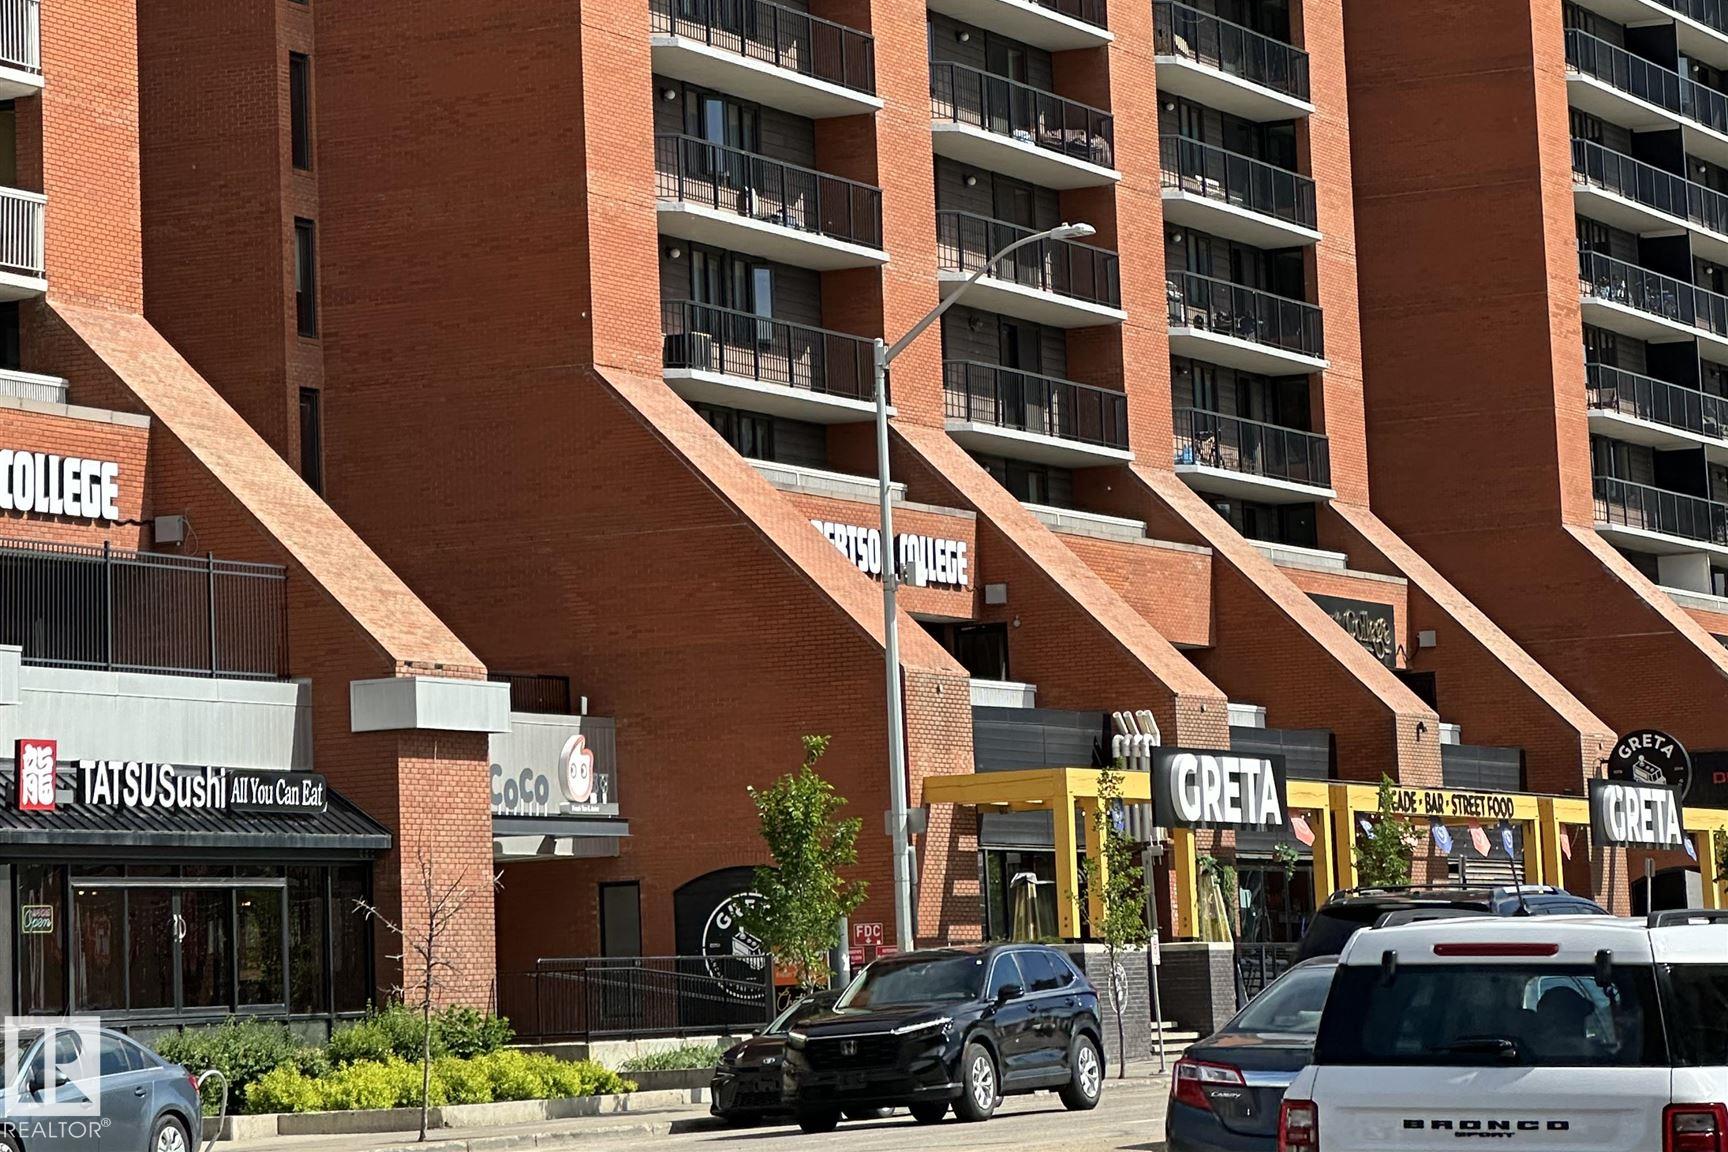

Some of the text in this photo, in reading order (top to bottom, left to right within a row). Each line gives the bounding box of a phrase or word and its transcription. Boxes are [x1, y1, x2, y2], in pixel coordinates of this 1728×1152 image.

[0, 448, 119, 521] COLLEGE
[1618, 734, 1674, 759] GRETA
[230, 776, 249, 803] All
[250, 776, 274, 805] You
[275, 779, 300, 806] Can
[301, 779, 323, 806] Eat
[1171, 753, 1283, 825] GRETA
[1425, 791, 1444, 815] BAR
[1451, 793, 1486, 817] STREET
[1488, 795, 1514, 819] FOOD
[1603, 784, 1683, 845] GRETA
[856, 924, 881, 938] FDC
[1403, 1119, 1570, 1131] BRONCO
